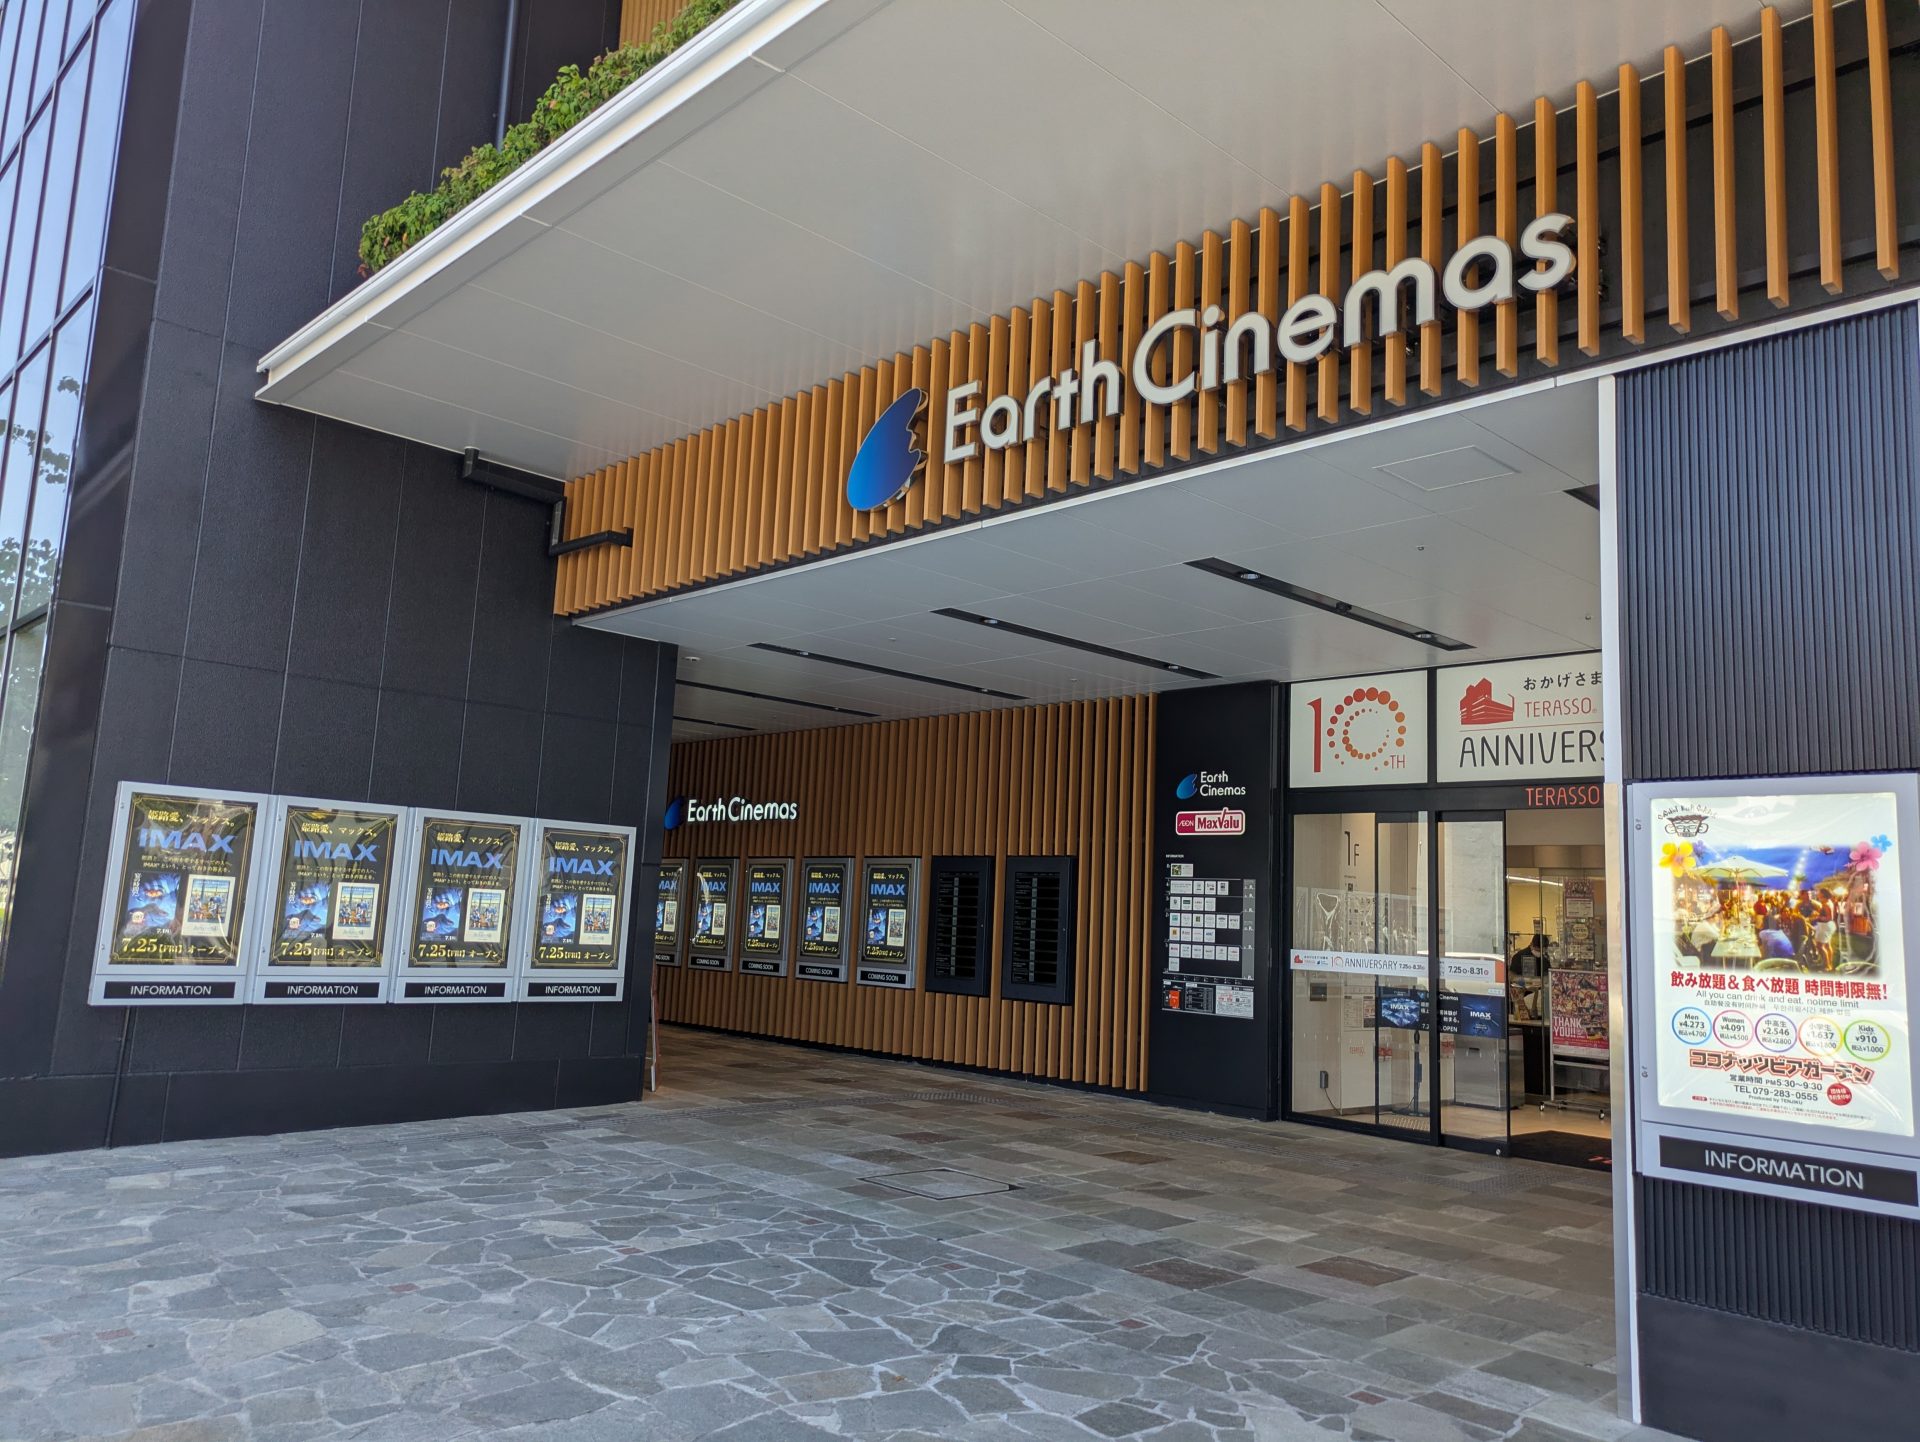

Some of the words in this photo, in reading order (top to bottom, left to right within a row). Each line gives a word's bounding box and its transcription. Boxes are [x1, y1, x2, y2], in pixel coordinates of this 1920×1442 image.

[1524, 697, 1592, 719] TERASSO
[1200, 771, 1228, 783] Earth
[1200, 784, 1246, 796] Cinemas
[1526, 785, 1600, 807] TERASSO
[1197, 809, 1240, 830] MaxValu
[139, 827, 236, 854] IMAX
[293, 840, 378, 862] IMAX
[431, 848, 504, 869] IMAX
[549, 857, 614, 876] IMAX
[751, 882, 780, 893] IMAX
[808, 882, 840, 894] IMAX
[870, 884, 905, 896] IMAX
[187, 945, 225, 955] オープン
[339, 948, 372, 956] オープン
[1345, 958, 1398, 970] ANNIVERSARY
[868, 973, 885, 981] COMING
[130, 985, 211, 995] INFORMATION
[287, 985, 358, 995] INFORMATION
[424, 986, 487, 995] INFORMATION
[545, 986, 600, 994] INFORMATION
[1696, 990, 1707, 998] All
[1709, 992, 1725, 1000] you
[1744, 992, 1766, 1002] drink
[1768, 995, 1785, 1004] and
[1840, 999, 1859, 1008] limit
[1553, 1016, 1582, 1029] THANK
[1722, 1016, 1744, 1024] Women
[1553, 1026, 1576, 1038] YOU!!
[1858, 1025, 1874, 1033] Kids
[1855, 1035, 1878, 1044] ¥910
[1690, 1050, 1875, 1085] ココナッツビアガーデン
[1729, 1074, 1762, 1085] 営業時間
[1734, 1085, 1751, 1094] TEL
[1752, 1086, 1818, 1101] 079-283-0555
[1705, 1149, 1864, 1190] INFORMATION
